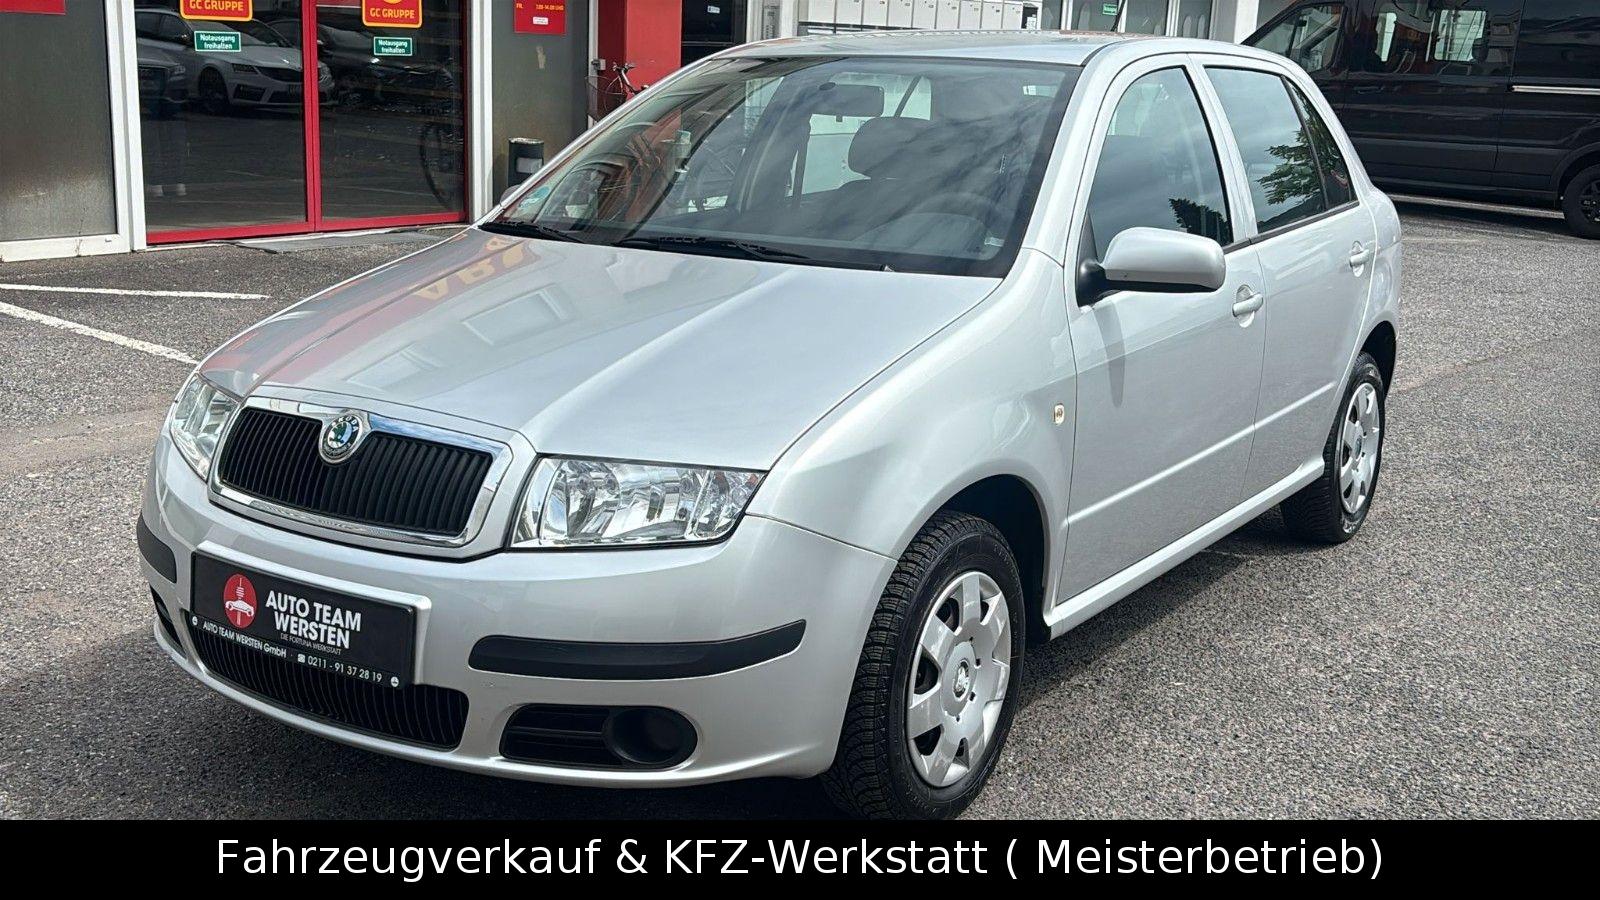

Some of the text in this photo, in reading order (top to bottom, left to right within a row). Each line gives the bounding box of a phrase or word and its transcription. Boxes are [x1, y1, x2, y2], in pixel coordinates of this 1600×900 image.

[204, 0, 244, 12] GRUPPE
[370, 8, 415, 19] GC GRUPPE
[200, 34, 236, 43] Notausgang
[378, 40, 408, 48] Notausgang
[204, 42, 233, 50] freihalten
[381, 46, 406, 54] freihalten
[265, 590, 362, 632] AUTO TEAM
[274, 611, 350, 649] WERSTEN
[203, 621, 287, 658] AUTO TEAM WERSTEN GmbH
[280, 633, 342, 655] DIE FORTUNA WERKSTATT
[307, 655, 327, 669] 0211
[334, 662, 344, 673] 91
[346, 665, 358, 676] 37
[359, 668, 370, 680] 28
[371, 671, 382, 683] 19
